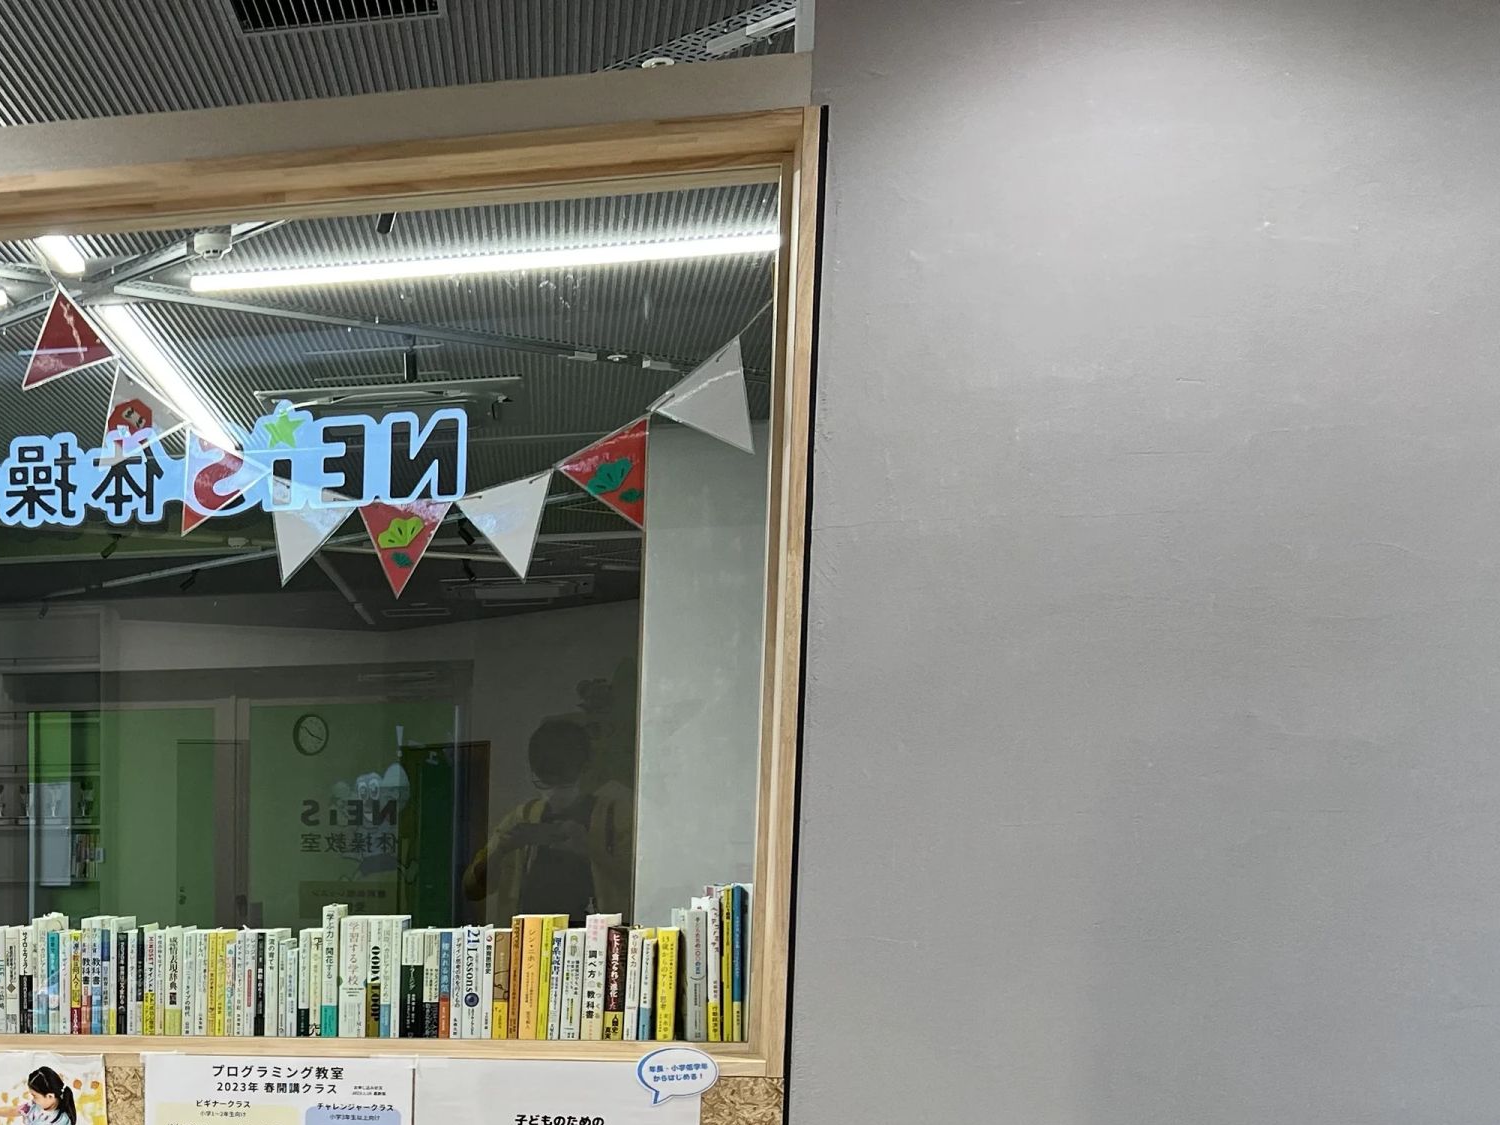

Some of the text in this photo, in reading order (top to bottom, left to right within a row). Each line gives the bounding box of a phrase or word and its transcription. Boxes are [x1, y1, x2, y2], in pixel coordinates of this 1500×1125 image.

[348, 921, 359, 986] 学習する学校
[528, 930, 536, 970] シン・ニホン
[466, 929, 480, 993] 21 Lessons
[212, 1065, 344, 1080] プログラミング教室
[217, 1082, 338, 1094] 2023年 春開講クラス
[196, 1100, 251, 1108] ビギナークラス
[317, 1102, 394, 1111] チャレンジャークラス
